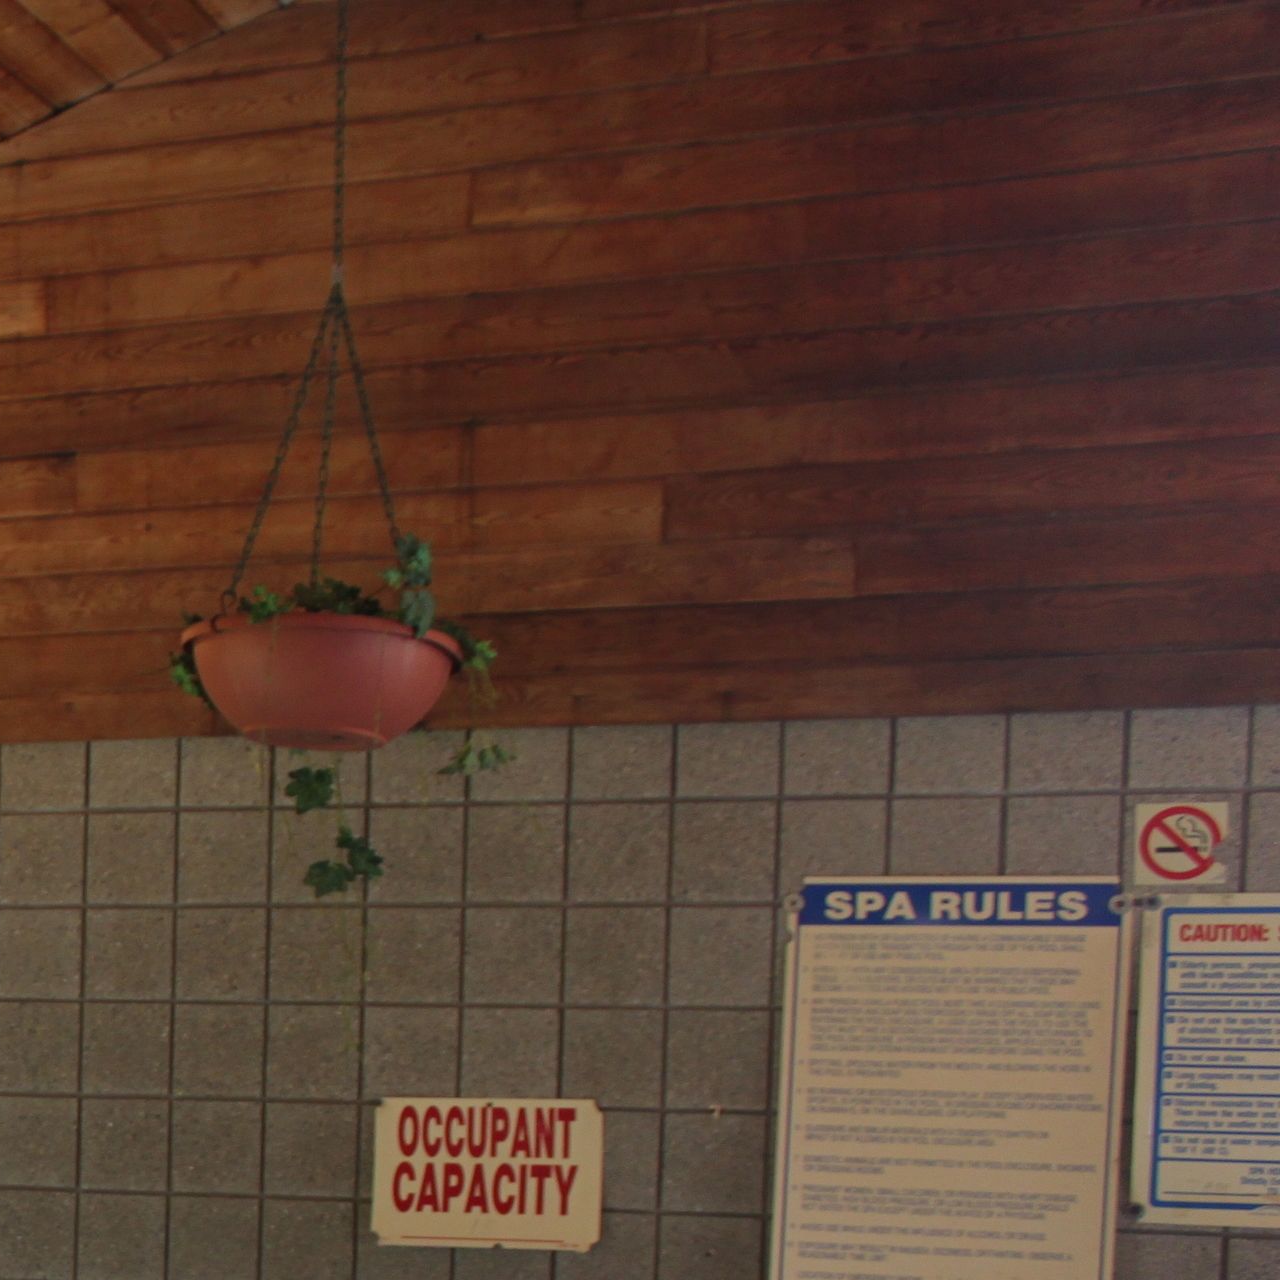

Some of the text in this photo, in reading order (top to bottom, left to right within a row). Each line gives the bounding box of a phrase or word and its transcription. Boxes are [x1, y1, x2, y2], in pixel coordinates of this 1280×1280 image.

[824, 890, 1089, 922] SPA RULES
[1179, 923, 1269, 942] CAUTION:
[398, 1104, 577, 1159] OCCUPANT
[392, 1161, 579, 1216] CAPACITY
